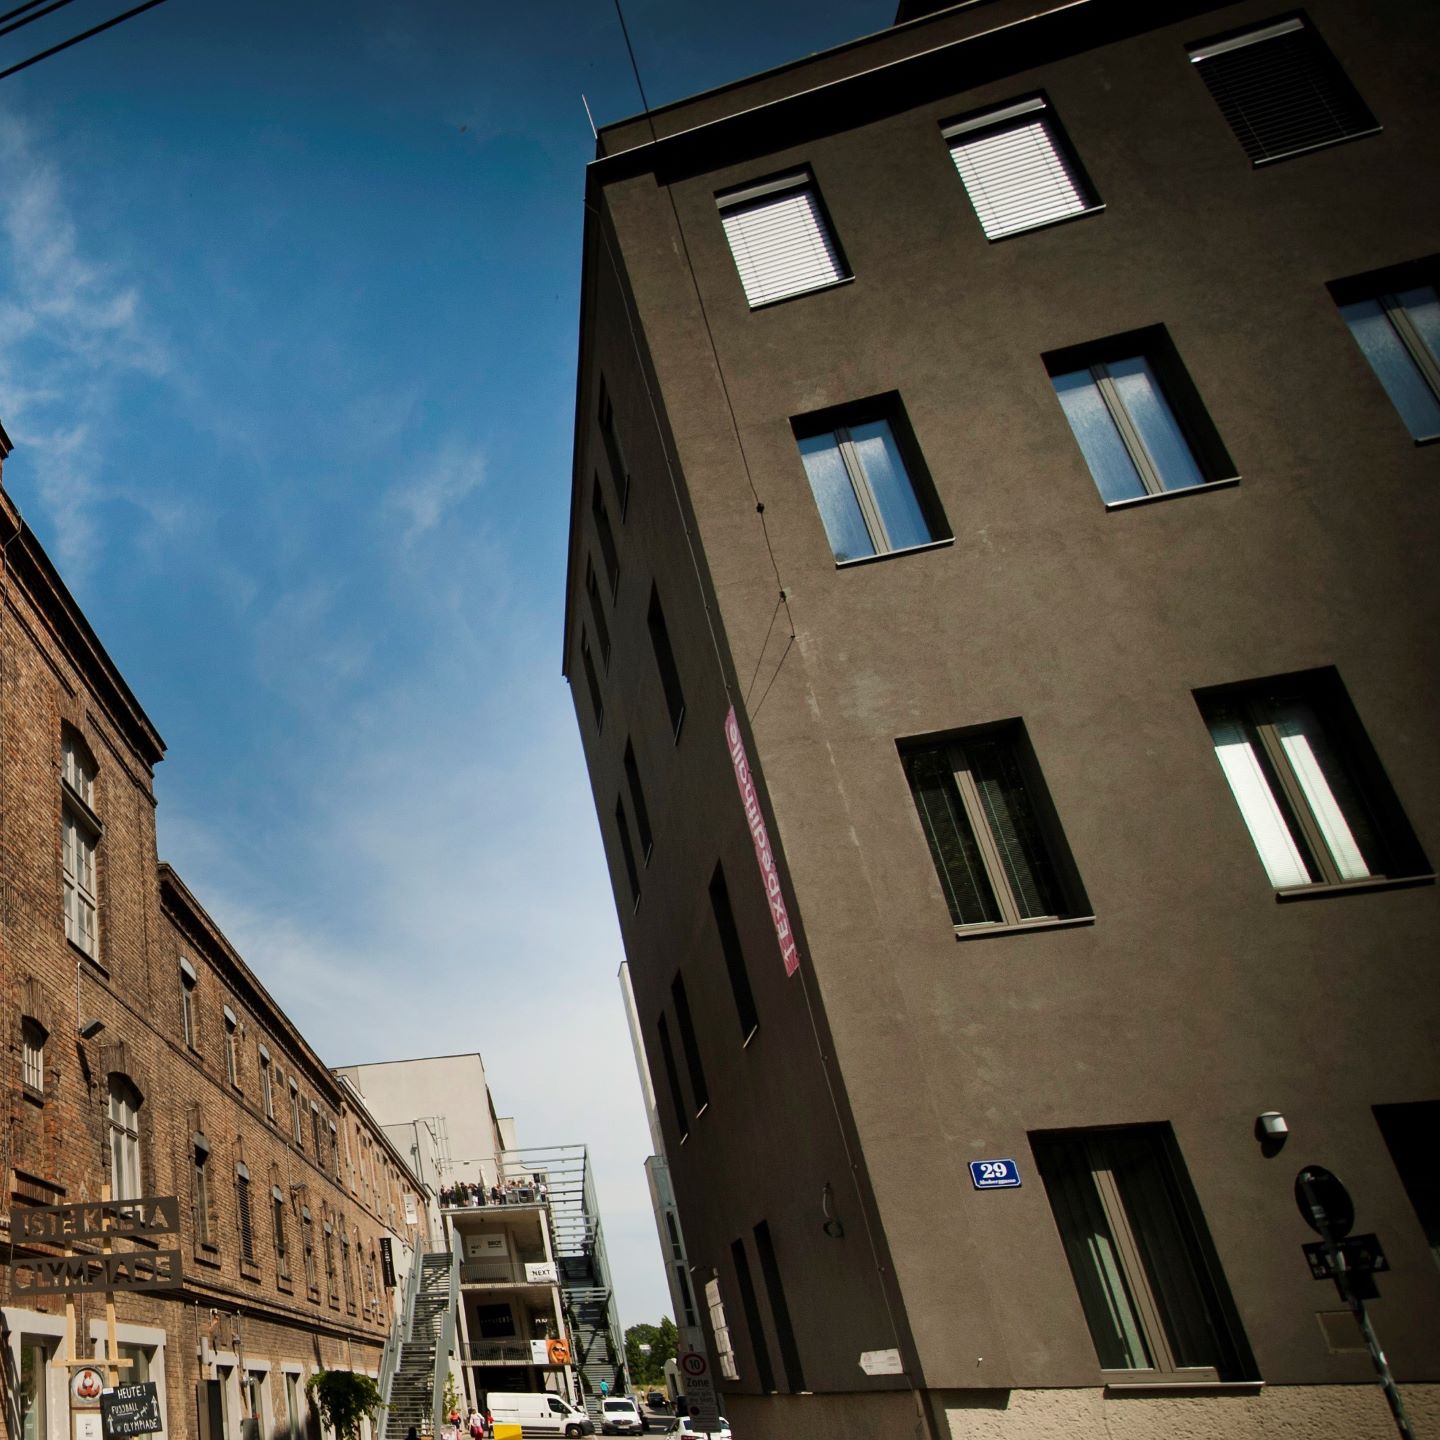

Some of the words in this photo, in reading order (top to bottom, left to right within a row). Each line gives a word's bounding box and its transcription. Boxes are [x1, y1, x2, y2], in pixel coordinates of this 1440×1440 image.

[980, 1162, 1008, 1178] 29
[14, 1255, 173, 1289] OLYMPIADE
[688, 1359, 700, 1370] 10
[686, 1378, 710, 1388] Zone
[111, 1402, 139, 1414] FUSSBALL
[123, 1418, 158, 1433] OLYMPIADE
